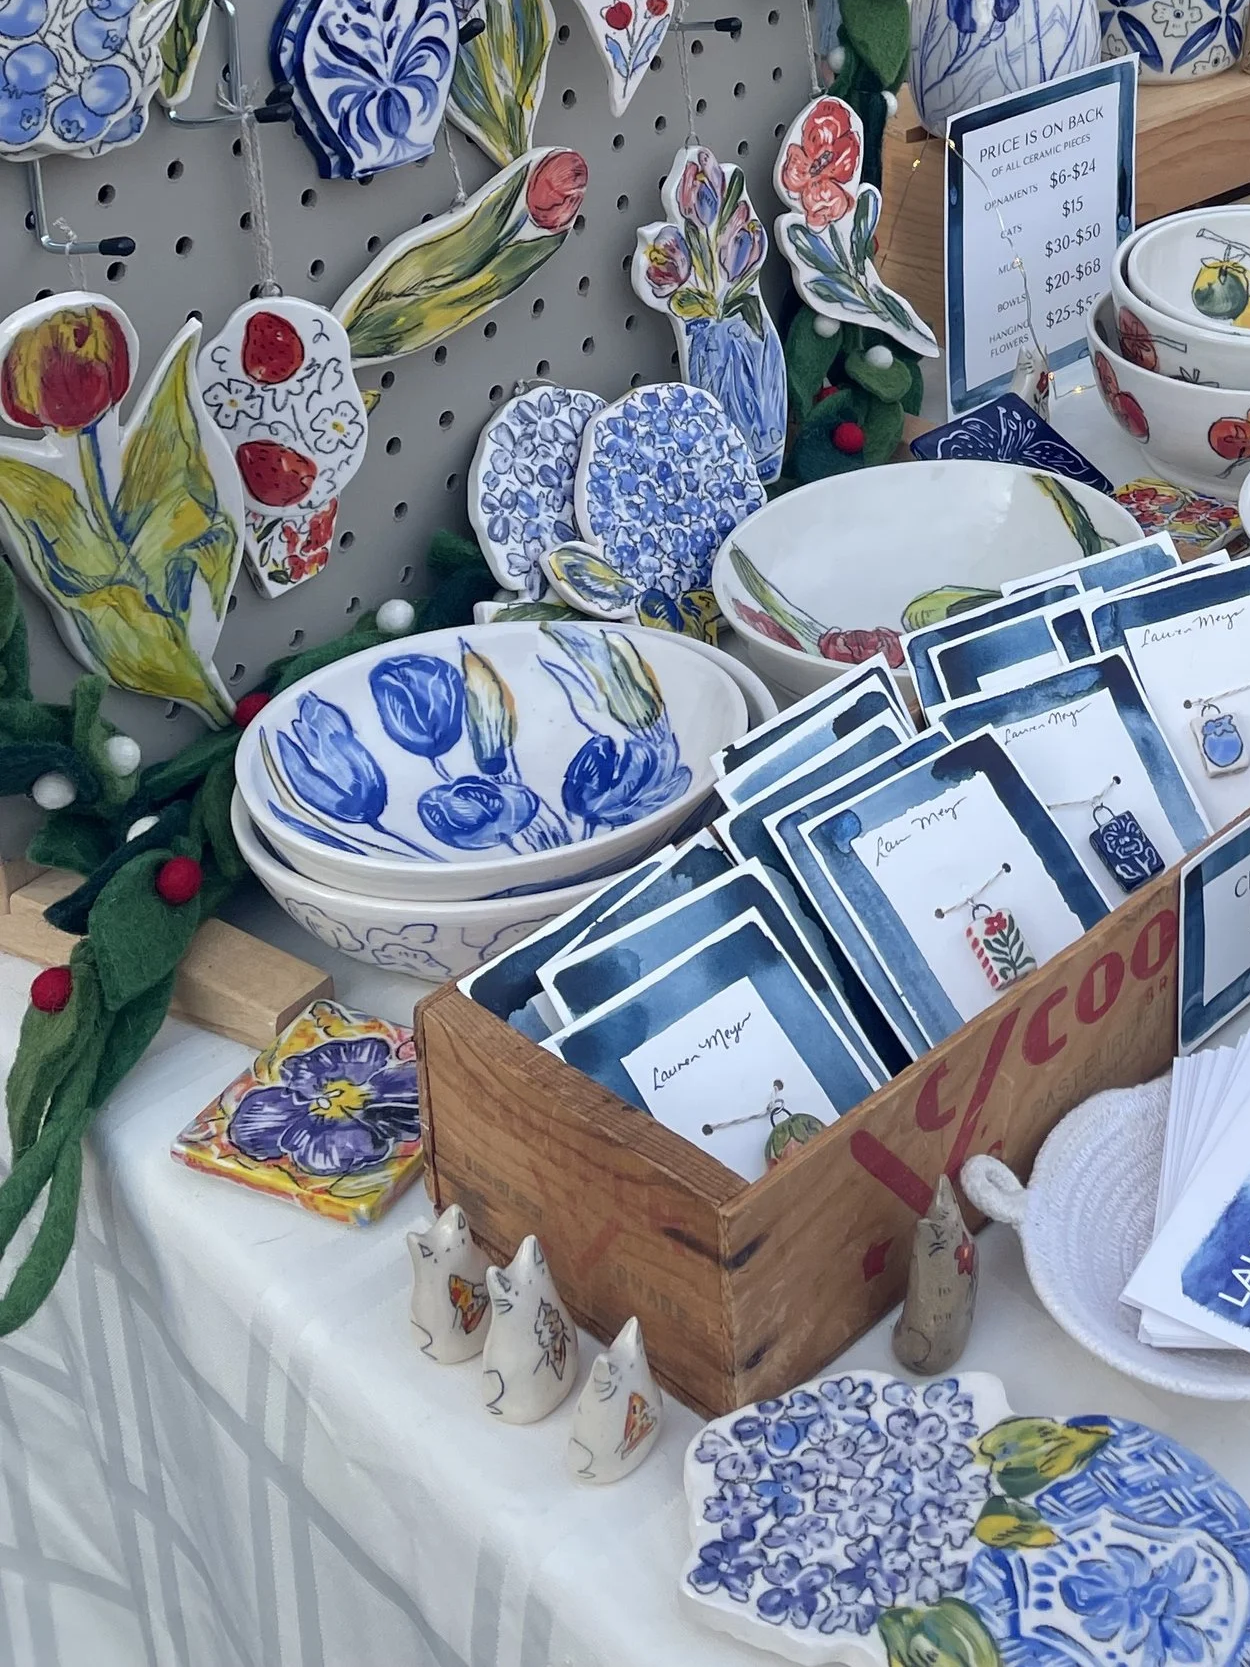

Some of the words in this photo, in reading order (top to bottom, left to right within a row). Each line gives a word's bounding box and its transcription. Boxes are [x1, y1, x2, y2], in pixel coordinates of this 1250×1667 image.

[979, 135, 1021, 163] PRICE
[1025, 129, 1038, 146] IS
[1042, 120, 1064, 139] ON
[1068, 104, 1104, 130] BACK
[991, 165, 1004, 178] OF
[1005, 160, 1021, 173] ALL
[1023, 144, 1062, 166] CERAMIC
[1063, 133, 1091, 150] PIECES
[1049, 158, 1096, 189] $6-$24
[1000, 223, 1023, 240] CATS
[1062, 195, 1083, 218] $15
[1045, 222, 1101, 258] $30-$50
[997, 293, 1028, 313] BOWLS
[1045, 257, 1101, 294] $20-$68
[990, 333, 1029, 358] FLOWERS
[1022, 909, 1178, 1067] COO
